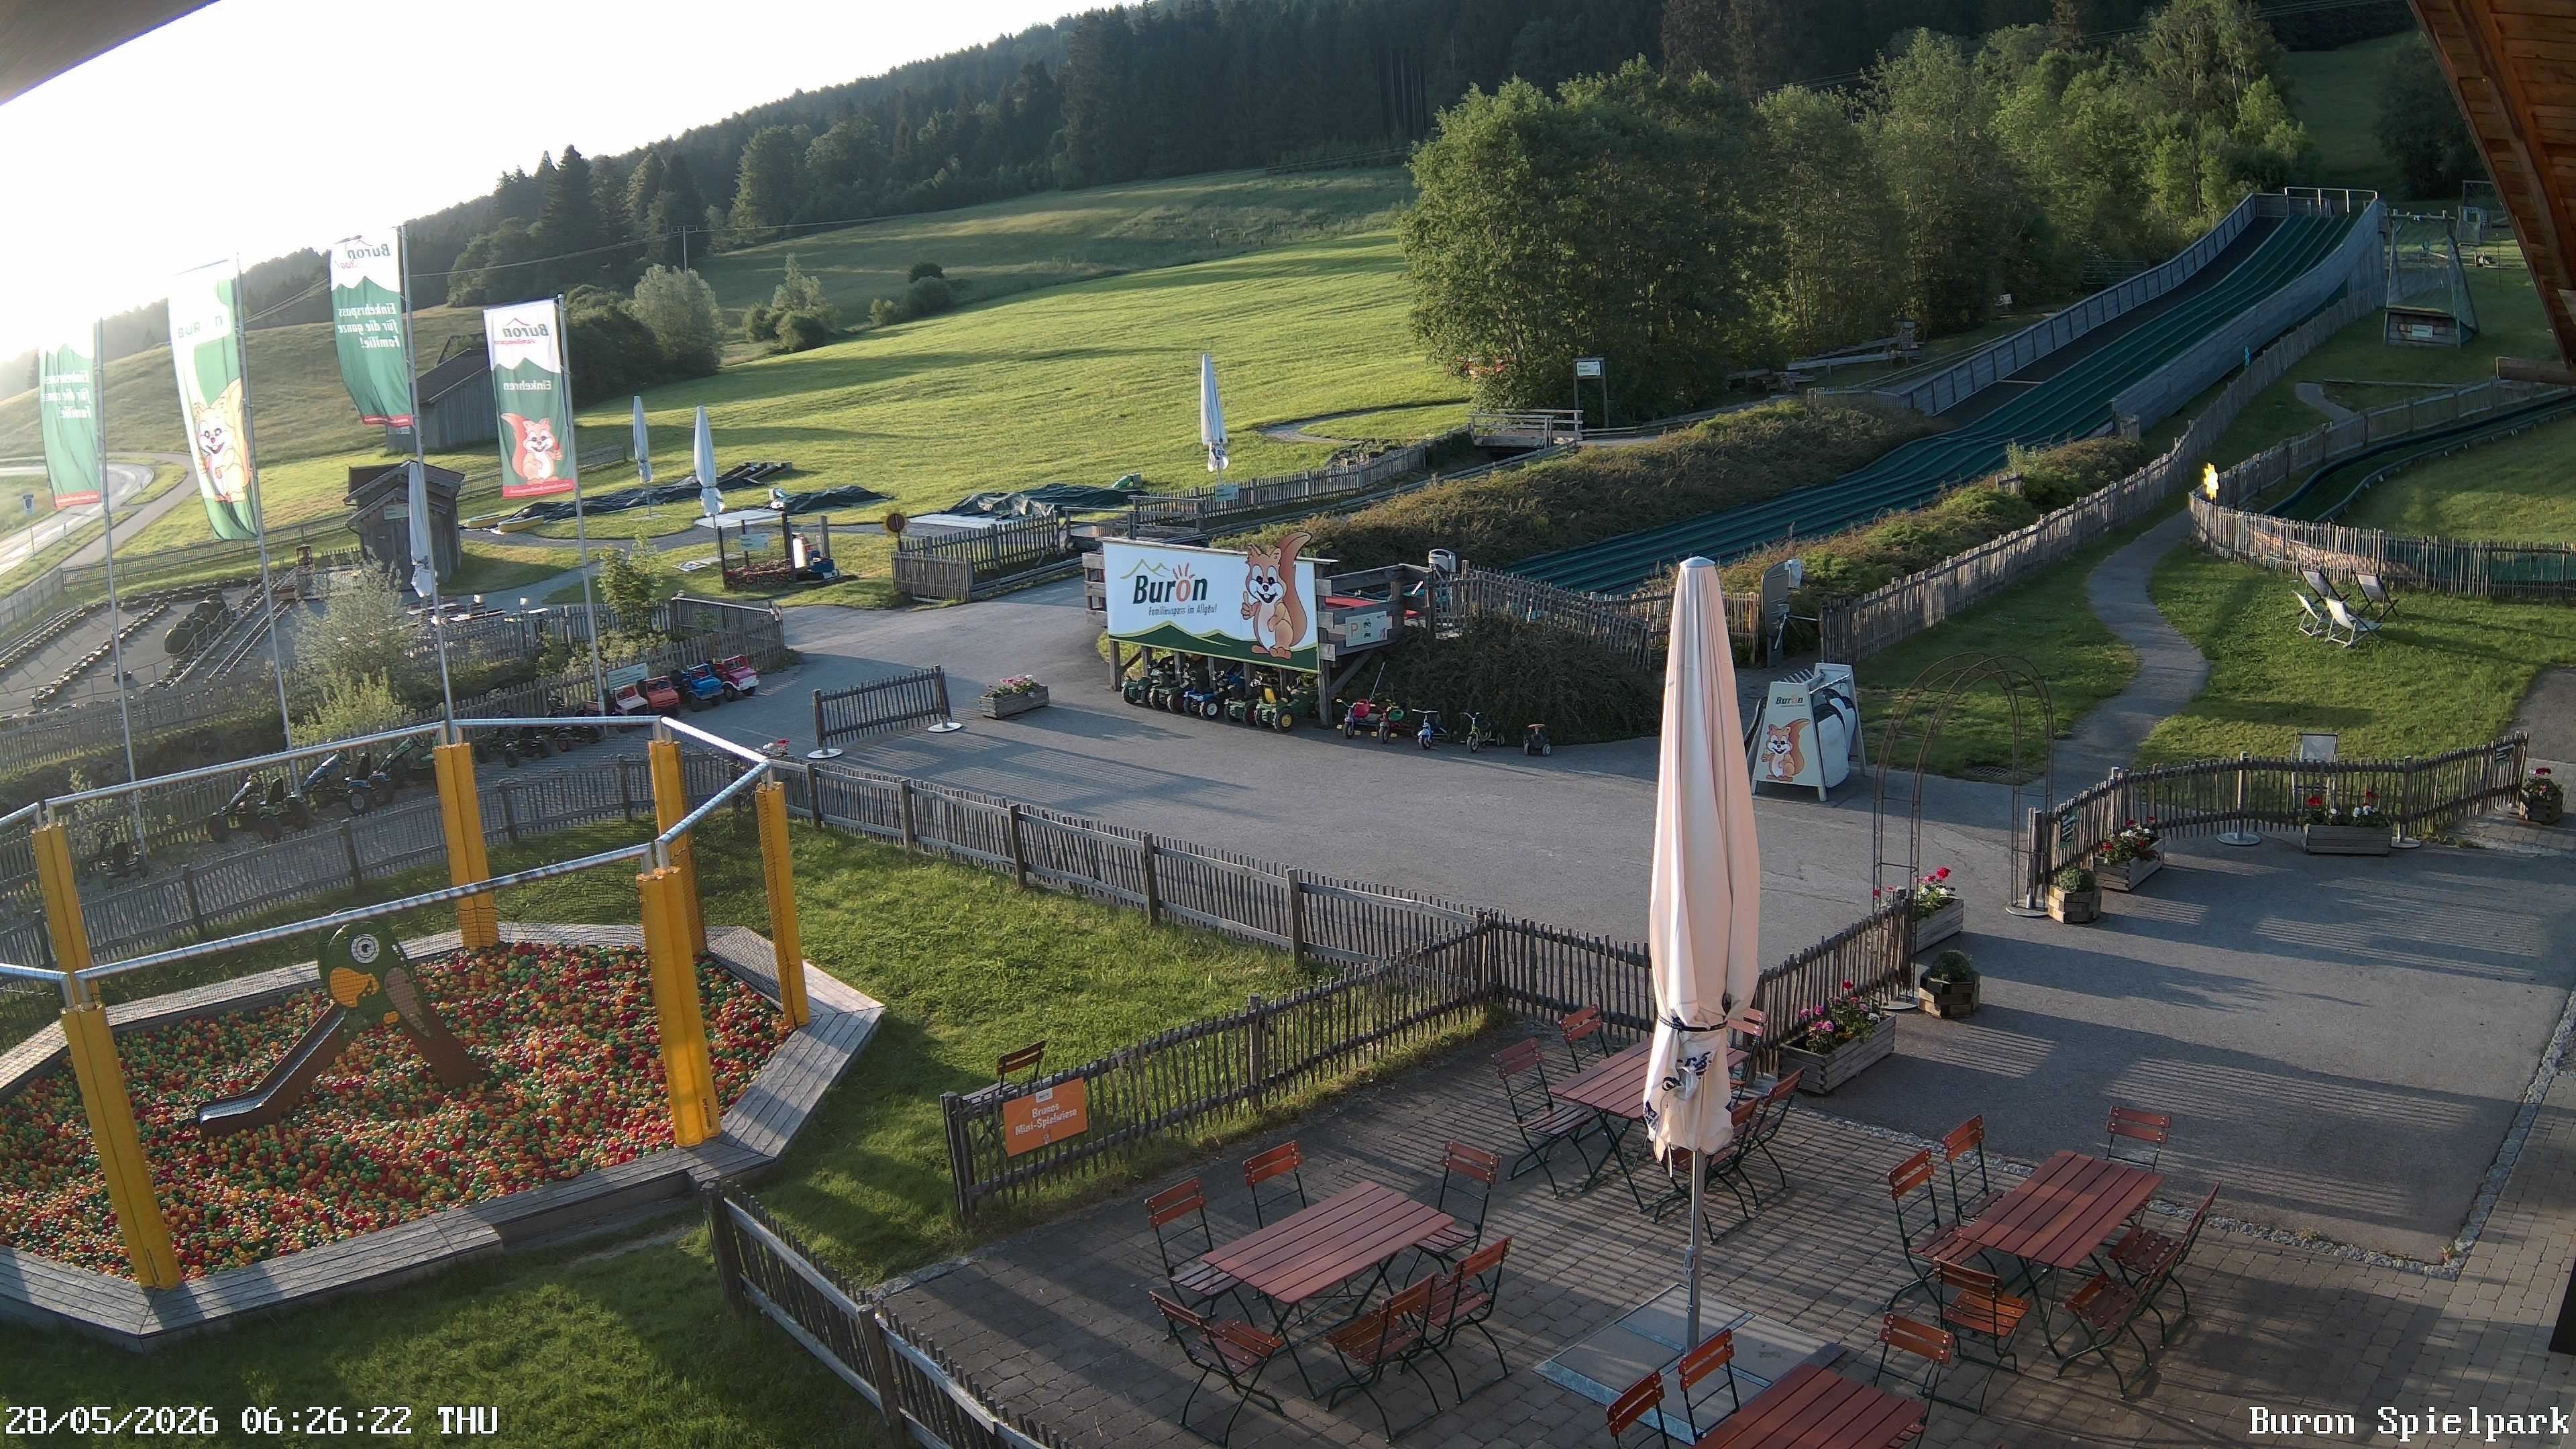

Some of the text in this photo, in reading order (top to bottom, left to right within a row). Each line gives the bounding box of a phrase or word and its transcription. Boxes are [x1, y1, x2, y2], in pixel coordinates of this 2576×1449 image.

[1133, 574, 1208, 604] Buron
[1187, 604, 1195, 614] im
[1350, 622, 1358, 639] P
